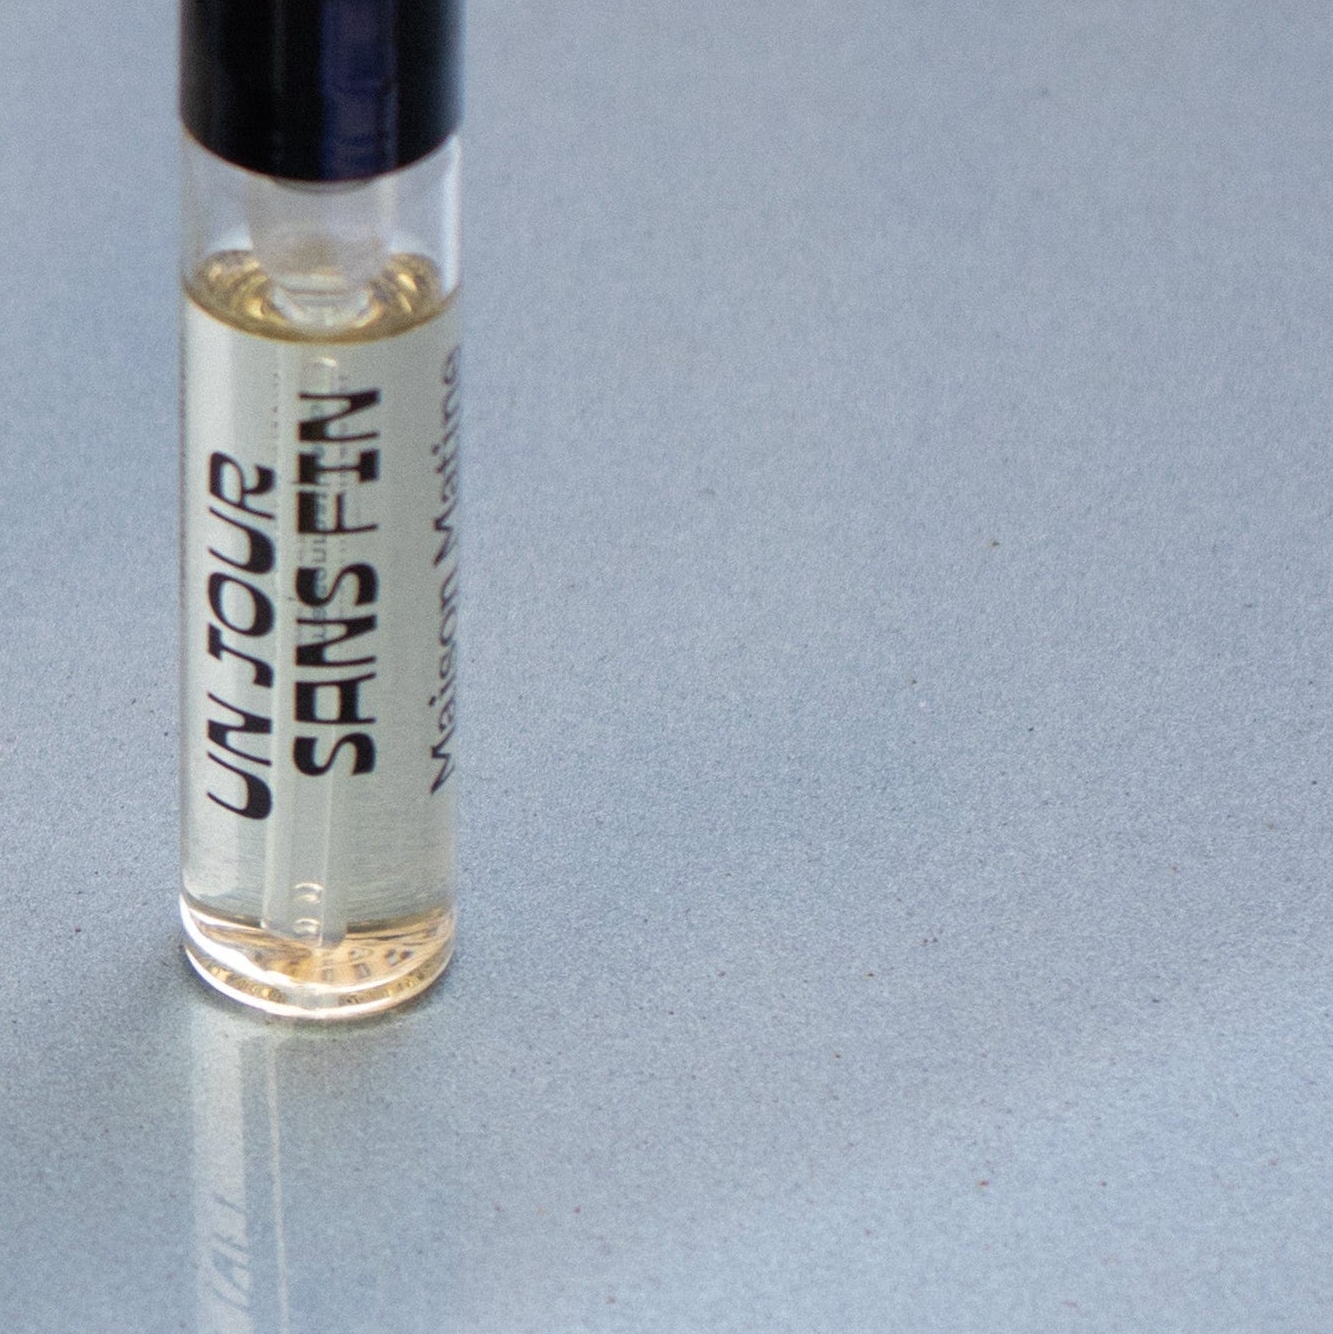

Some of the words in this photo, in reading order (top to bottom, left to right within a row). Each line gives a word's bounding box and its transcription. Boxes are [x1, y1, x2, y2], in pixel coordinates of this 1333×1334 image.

[296, 389, 380, 536] FIN
[432, 344, 461, 567] Matine
[207, 451, 276, 690] JOUR
[292, 562, 379, 778] SANS
[207, 692, 273, 821] UN
[429, 569, 459, 795] Maison
